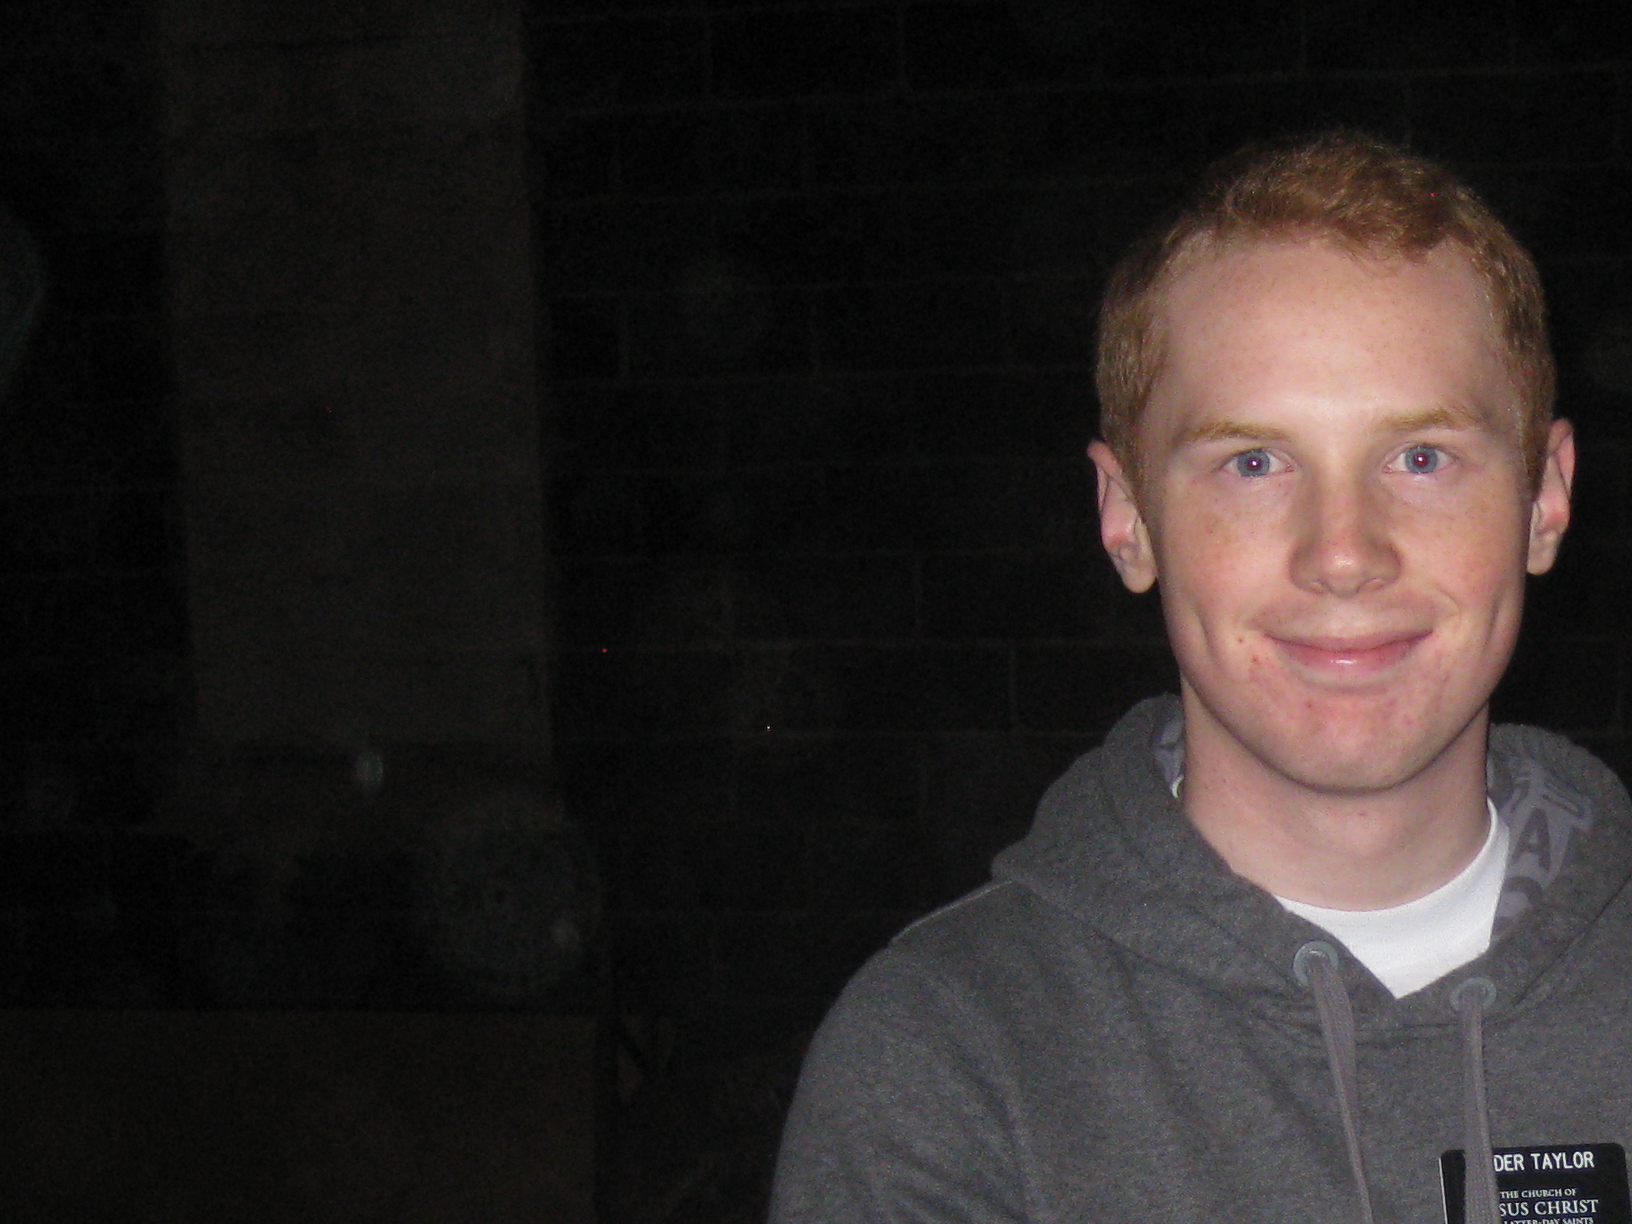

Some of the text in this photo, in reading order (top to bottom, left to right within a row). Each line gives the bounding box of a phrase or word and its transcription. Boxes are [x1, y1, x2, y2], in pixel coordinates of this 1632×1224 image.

[1493, 1151, 1595, 1172] DER TAYLOR
[1500, 1187, 1577, 1199] THE CHURCH OF
[1498, 1199, 1599, 1217] SUS CHRIST
